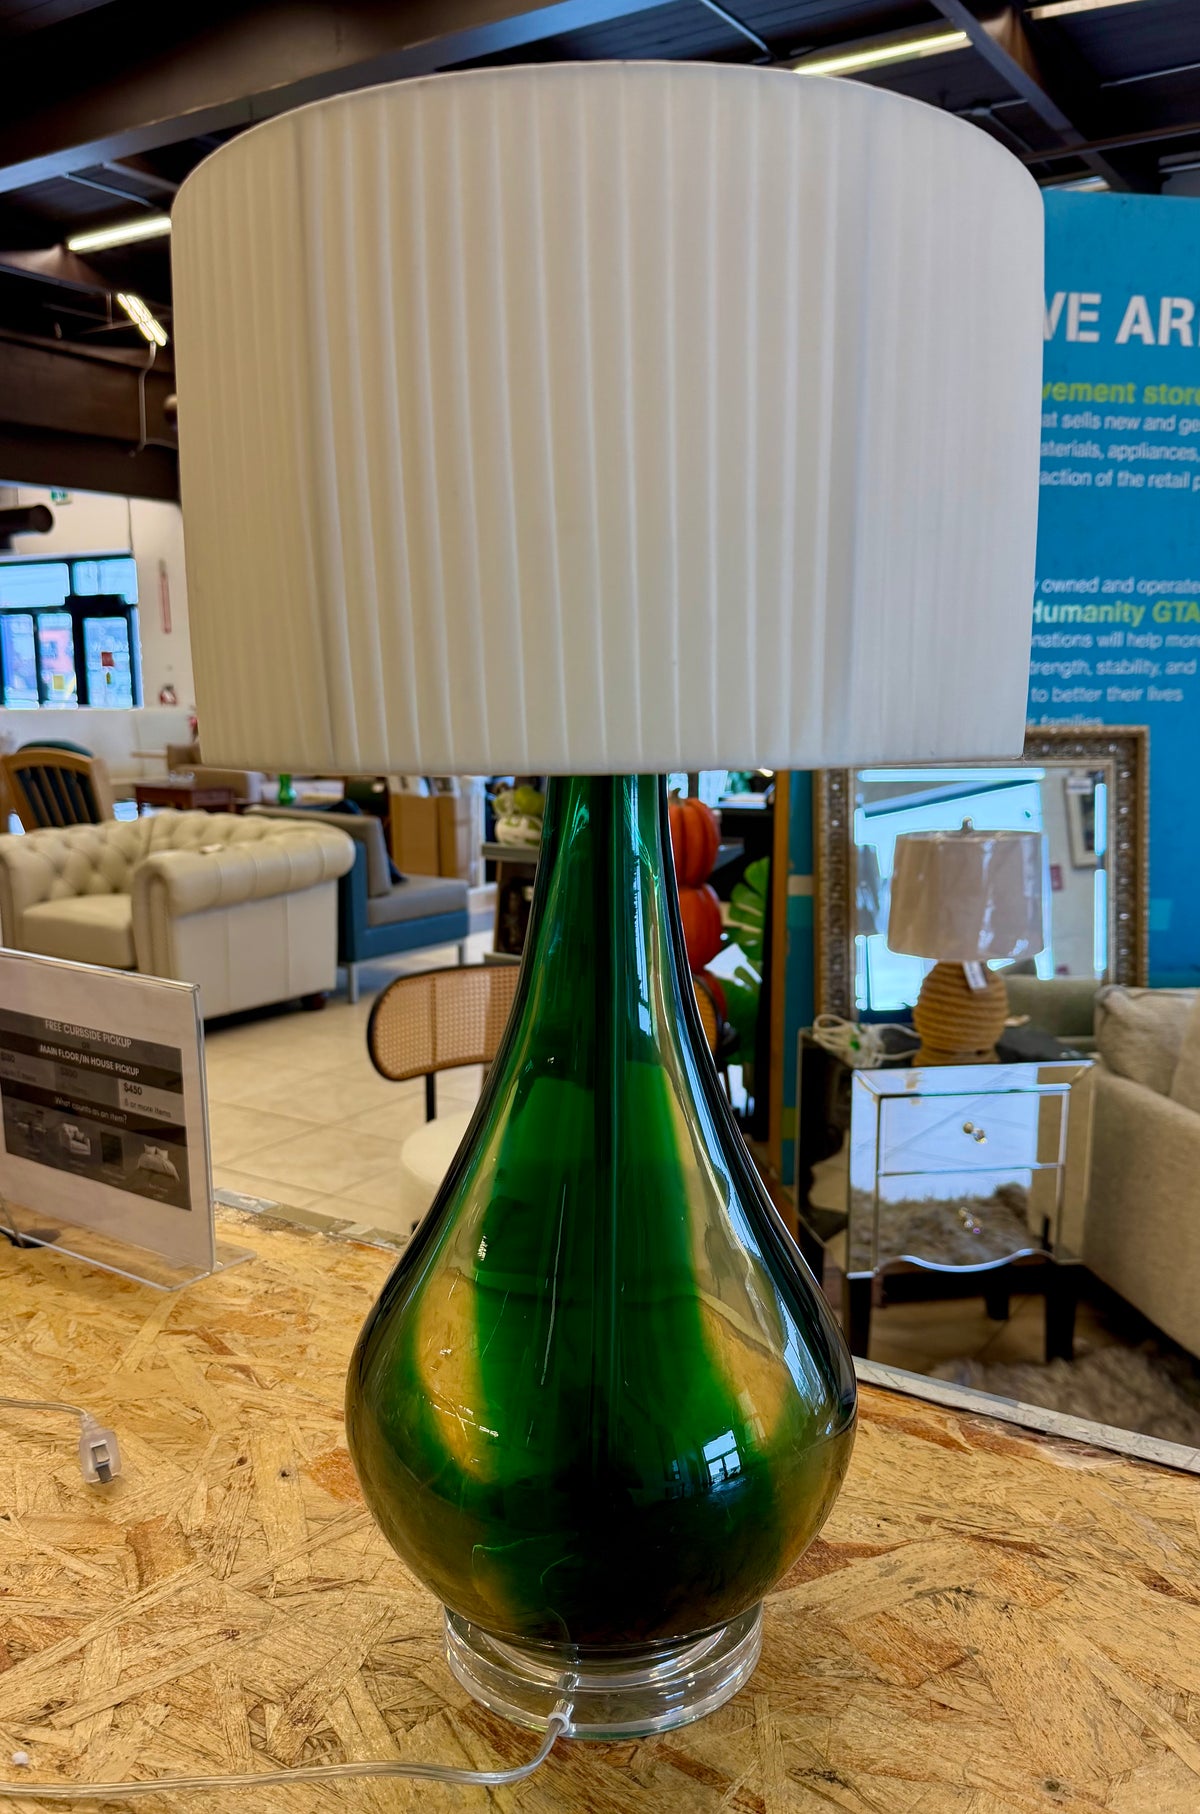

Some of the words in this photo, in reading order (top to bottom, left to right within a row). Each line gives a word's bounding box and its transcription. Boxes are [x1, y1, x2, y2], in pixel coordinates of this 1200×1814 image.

[1061, 411, 1101, 430] sells
[1103, 415, 1141, 430] new
[1143, 414, 1176, 432] and
[1094, 469, 1114, 487] of
[1117, 470, 1145, 488] the
[1148, 471, 1190, 489] retail
[1041, 577, 1099, 593] owned
[1101, 577, 1135, 593] and
[1096, 631, 1125, 647] will
[1126, 632, 1163, 650] help
[1165, 659, 1197, 675] and
[1031, 687, 1049, 702] to
[1052, 686, 1102, 703] better
[1106, 686, 1144, 702] their
[1147, 685, 1184, 702] lives
[63, 1024, 102, 1041] CURBSIDE
[103, 1033, 132, 1048] PICKUP
[39, 1044, 58, 1056] MAIN
[90, 1057, 114, 1071] HOUSE
[114, 1062, 140, 1077] PICKUP
